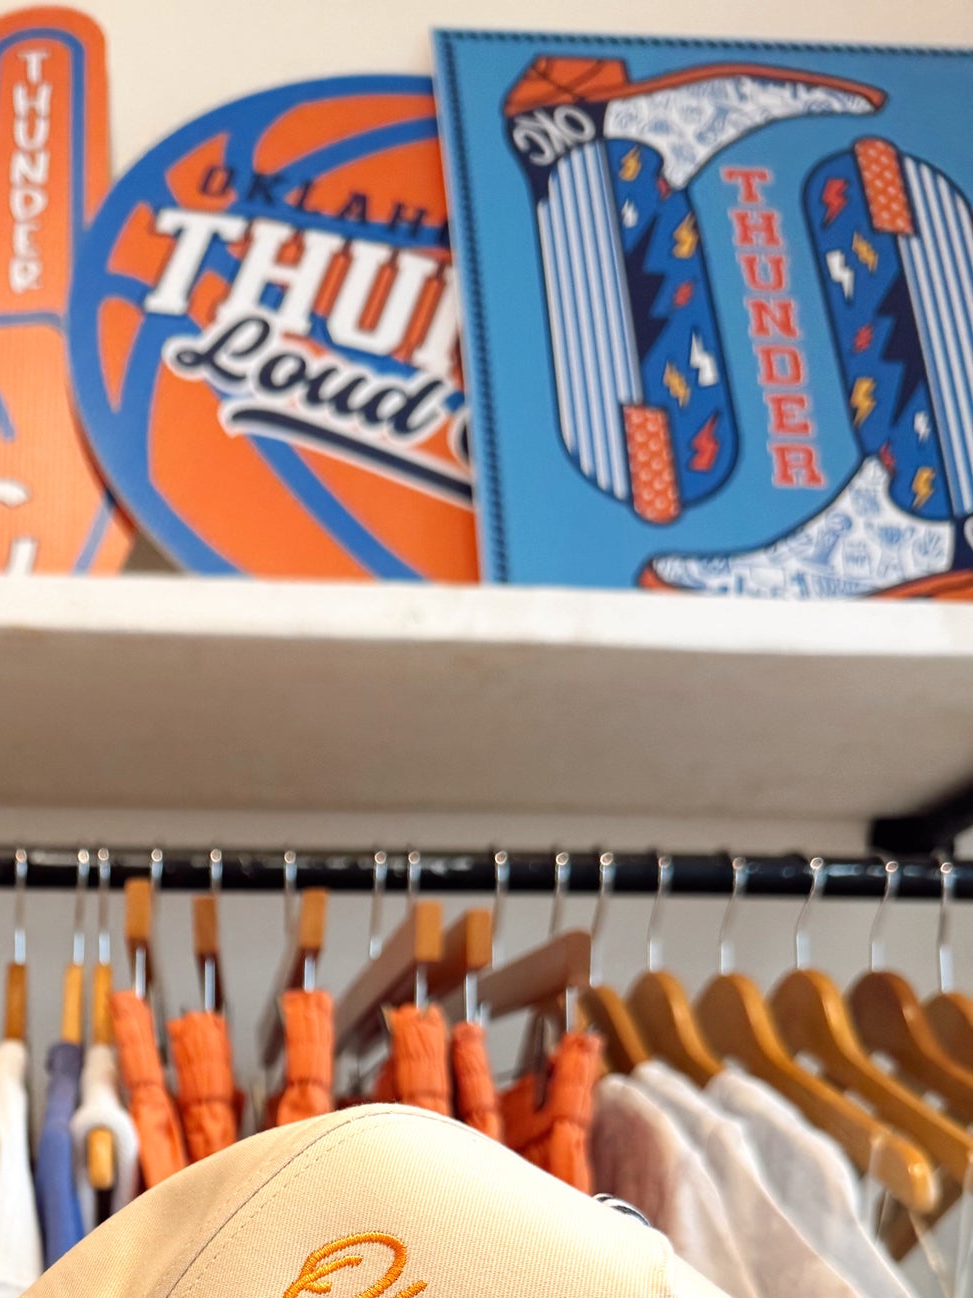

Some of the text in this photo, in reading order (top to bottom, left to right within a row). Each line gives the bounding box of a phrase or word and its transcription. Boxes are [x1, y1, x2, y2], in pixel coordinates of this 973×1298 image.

[8, 48, 52, 293] THUNDER
[169, 314, 448, 438] Loud
[721, 166, 827, 488] THUNDER
